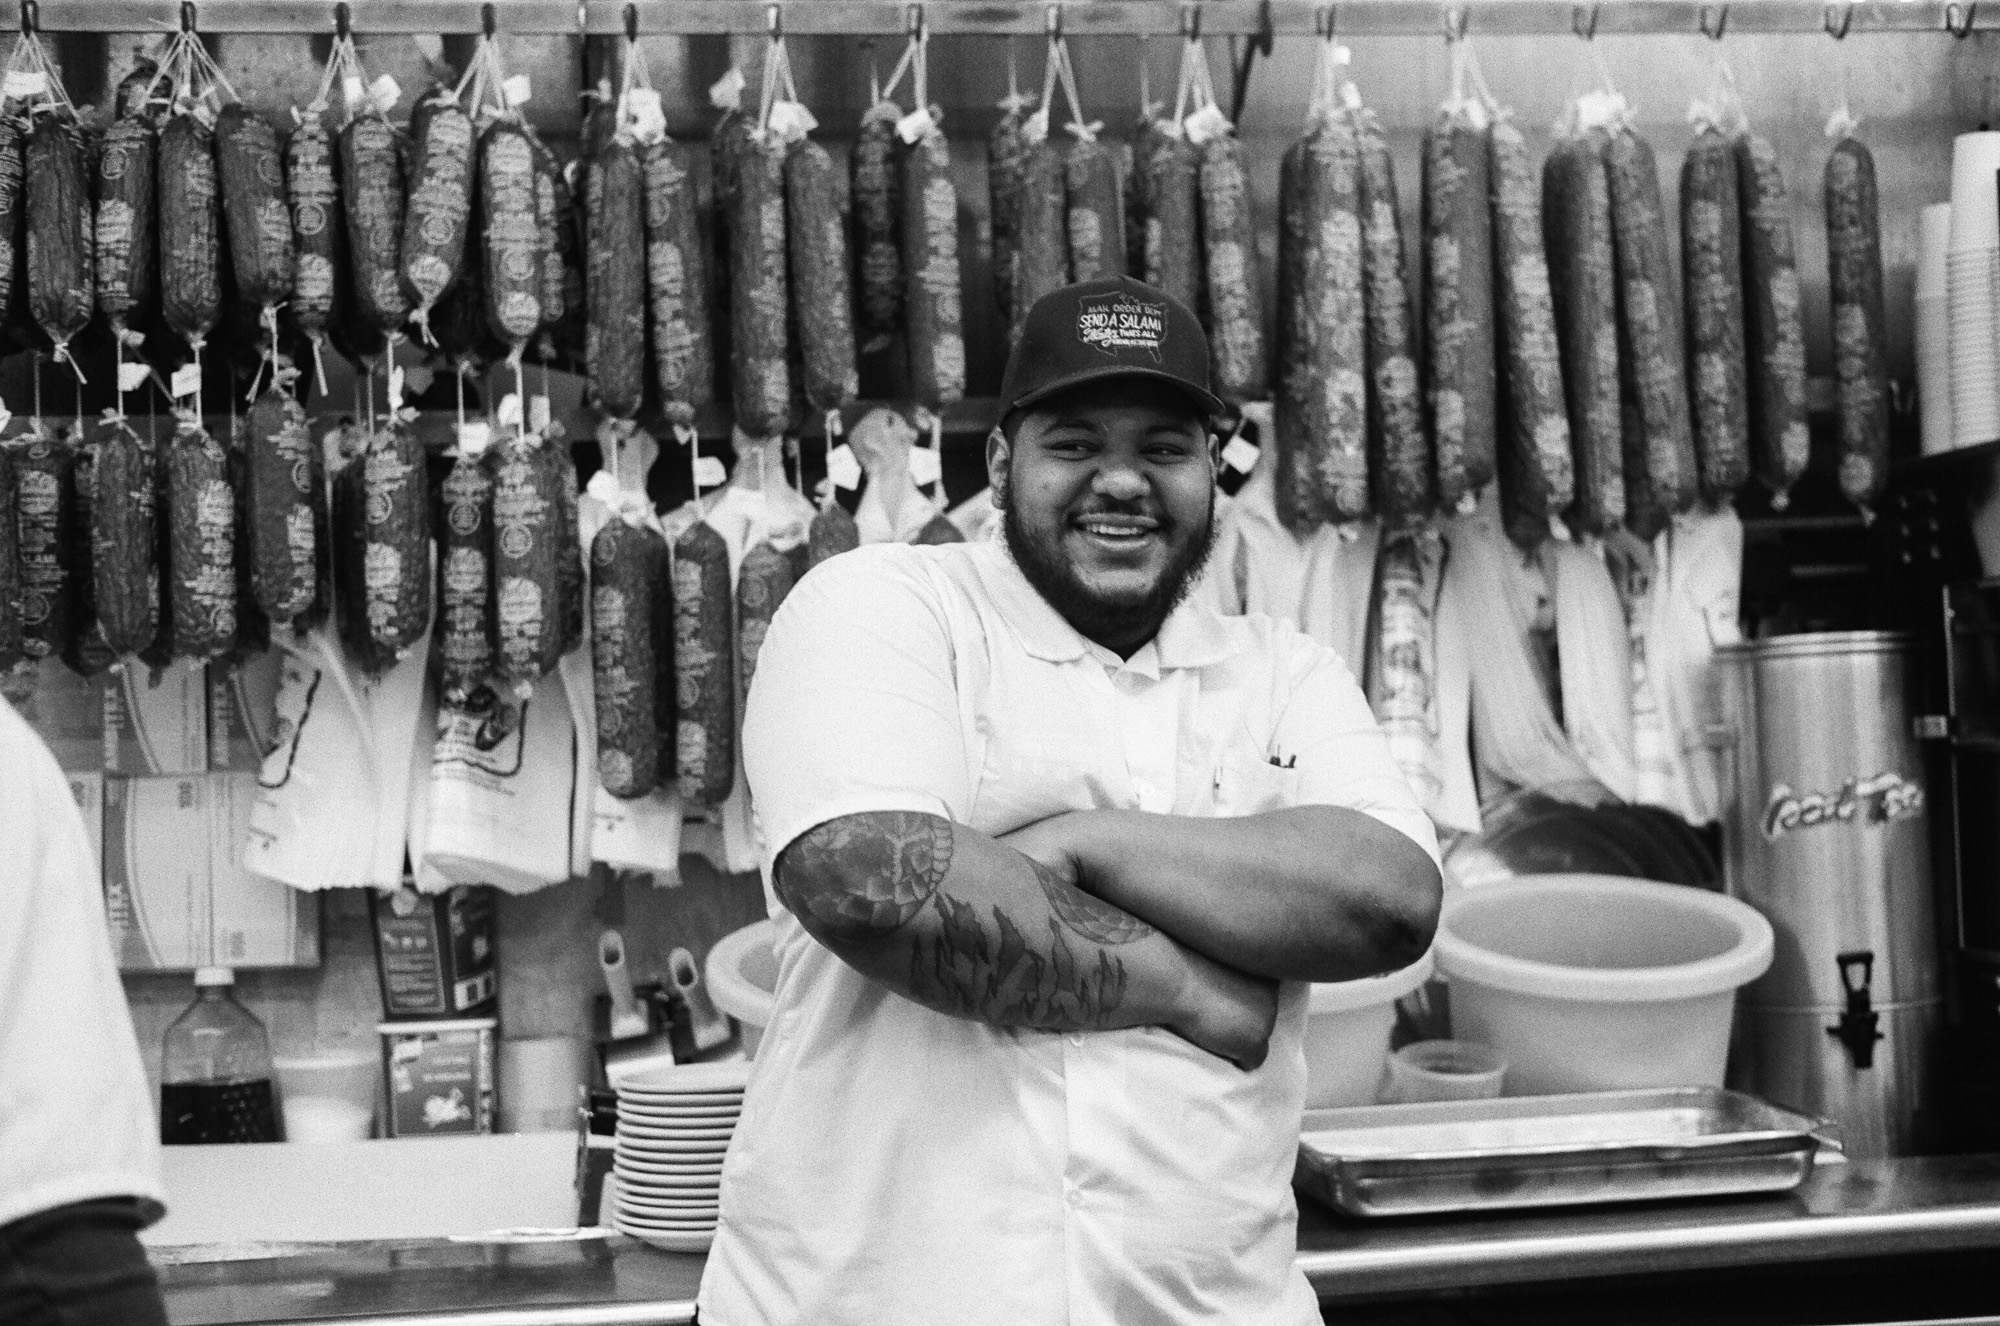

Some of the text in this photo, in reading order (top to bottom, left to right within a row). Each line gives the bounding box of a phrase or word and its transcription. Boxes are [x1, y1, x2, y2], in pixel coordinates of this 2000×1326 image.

[1112, 304, 1141, 314] ORDER
[1079, 313, 1162, 332] SEND A SALAMI
